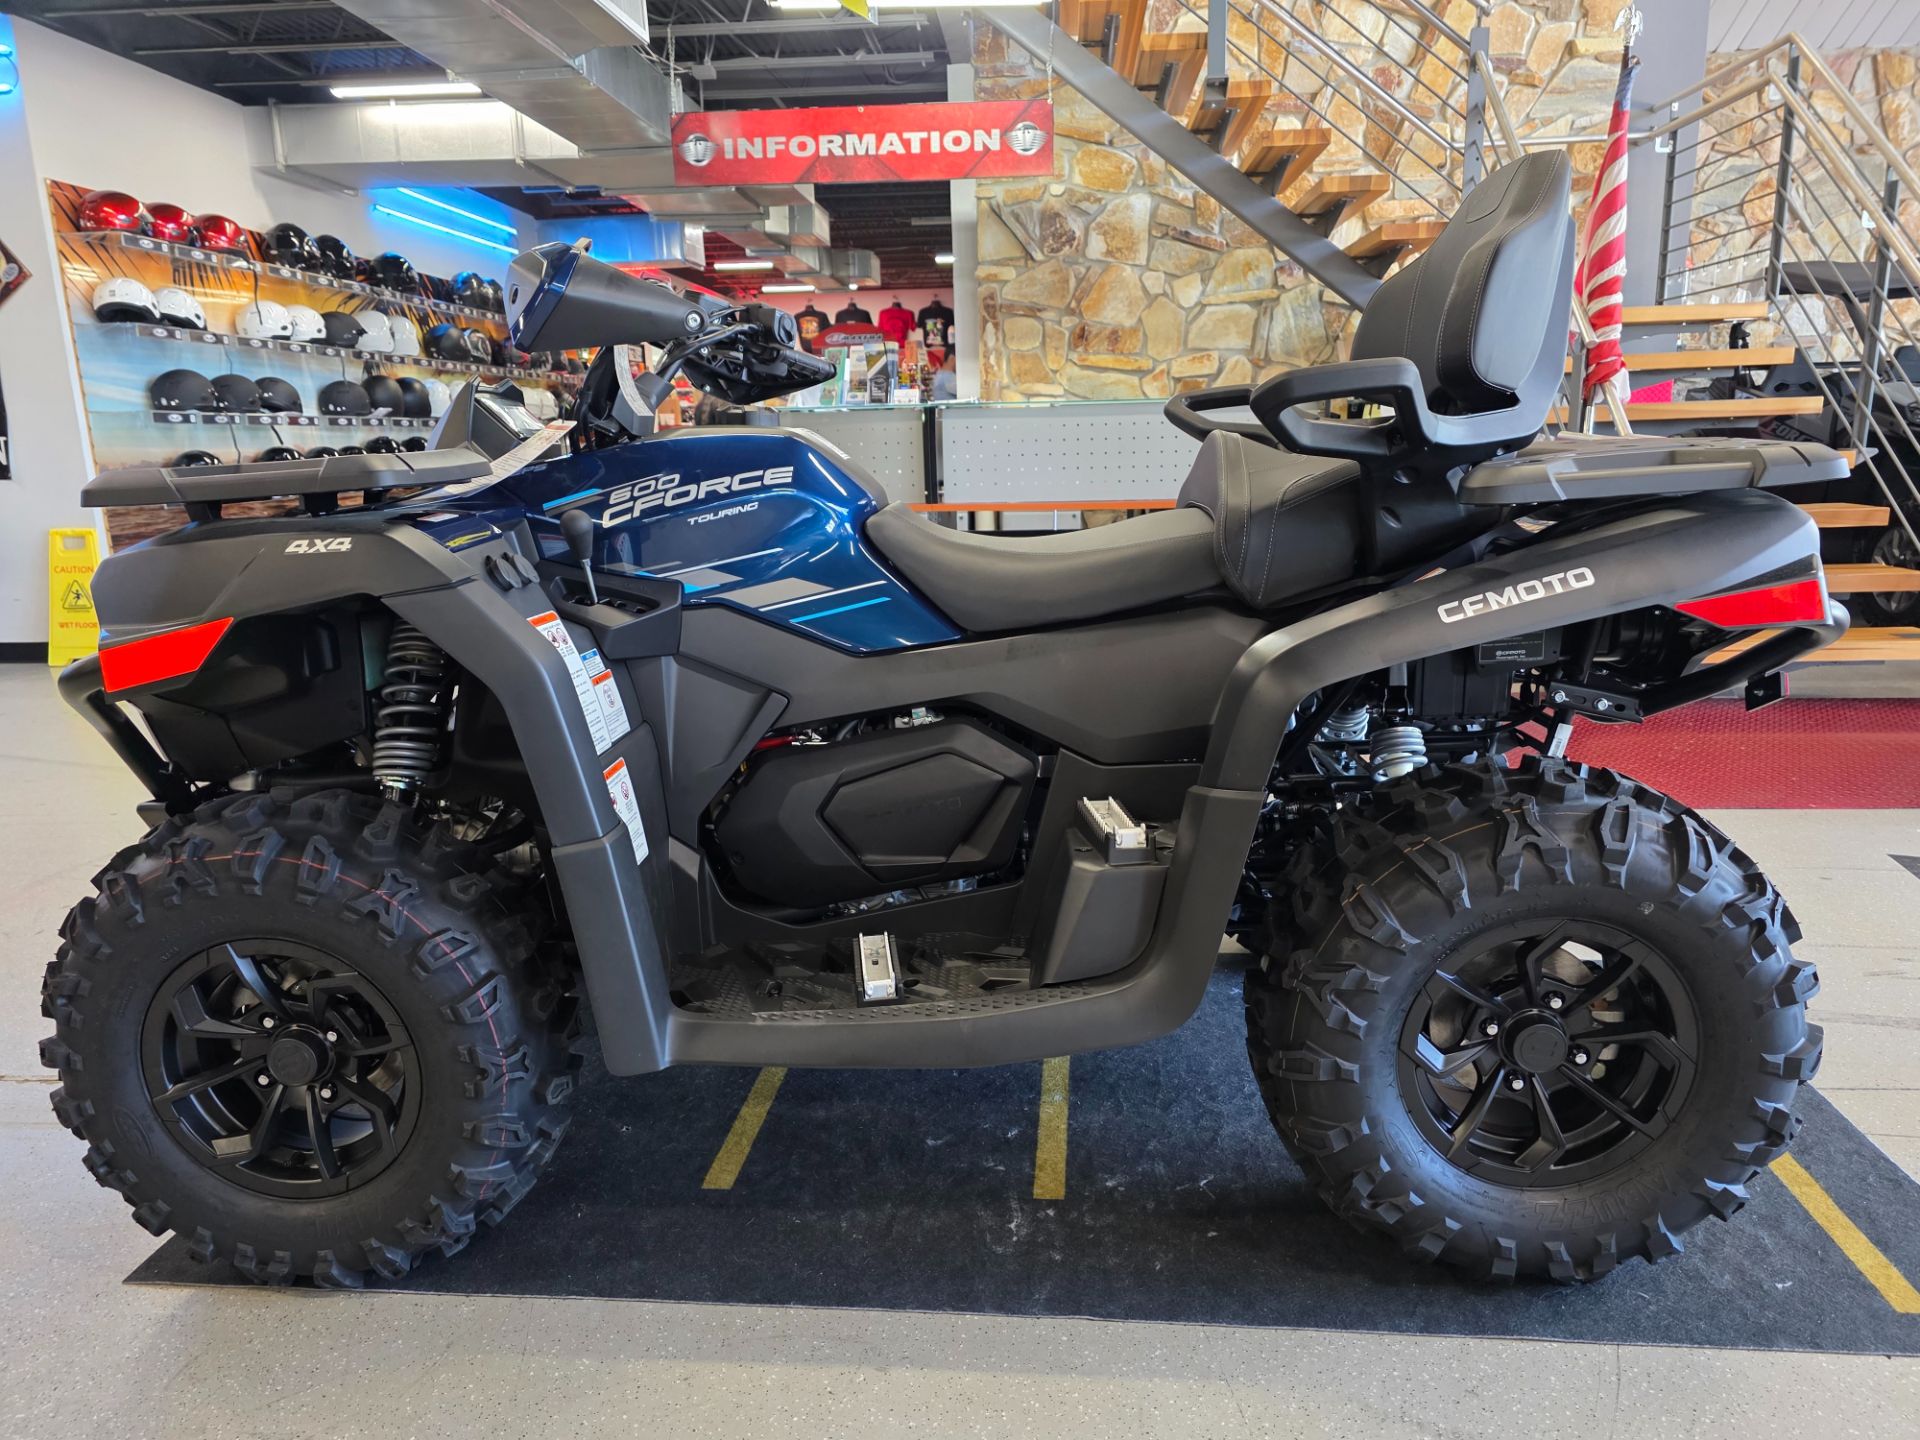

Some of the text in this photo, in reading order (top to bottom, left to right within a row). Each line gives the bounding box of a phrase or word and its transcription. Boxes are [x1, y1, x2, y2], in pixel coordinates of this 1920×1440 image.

[723, 129, 1000, 159] INFORMATION
[602, 466, 794, 528] CFORCE
[687, 502, 758, 525] TOURING
[284, 537, 352, 554] 4X4
[54, 565, 94, 574] CAUTION
[1437, 566, 1595, 623] CFMOTO
[58, 621, 98, 629] WET FLOOR
